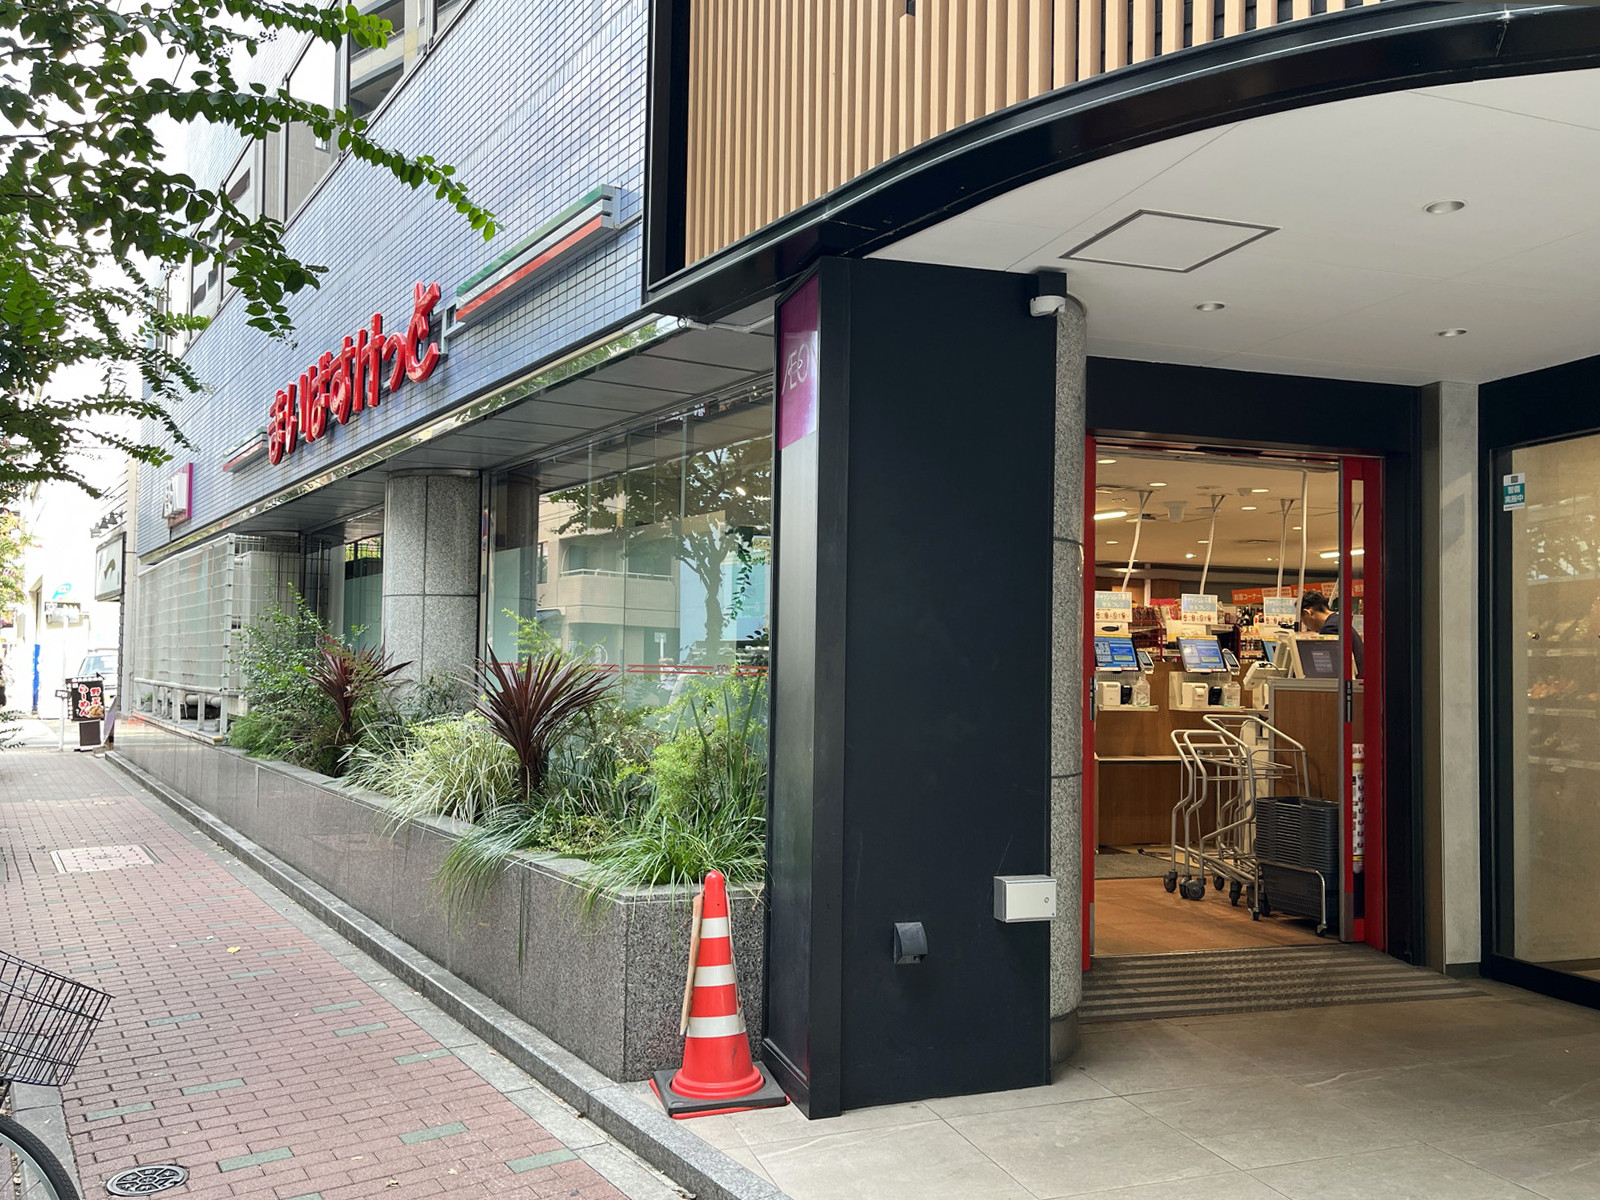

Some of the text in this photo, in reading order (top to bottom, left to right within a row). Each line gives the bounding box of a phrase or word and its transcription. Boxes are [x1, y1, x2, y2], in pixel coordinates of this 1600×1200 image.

[268, 281, 441, 465] まいばすけっと
[78, 684, 90, 717] らーめん
